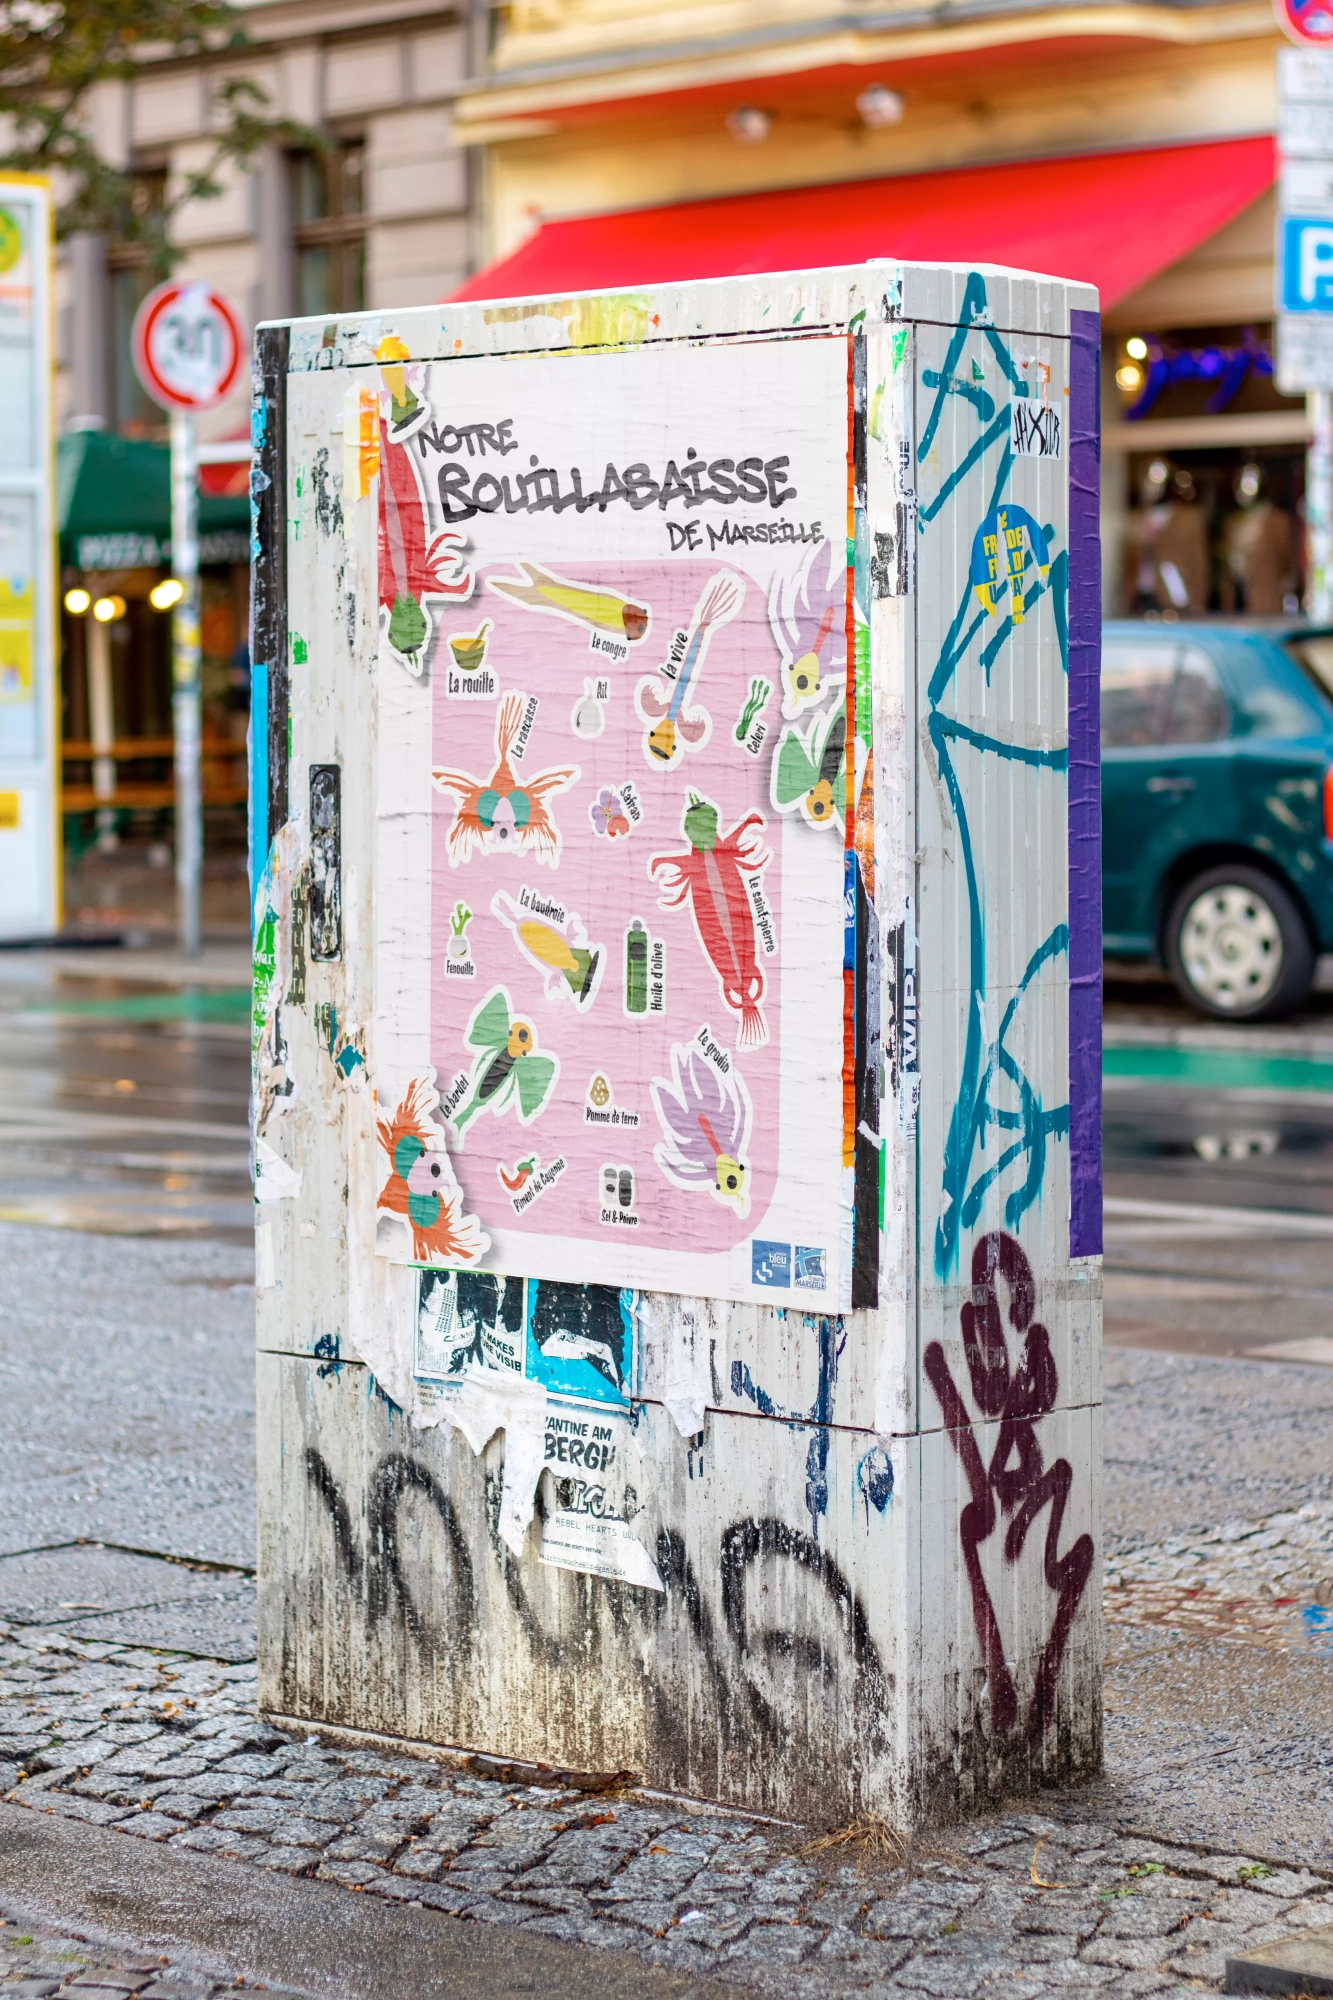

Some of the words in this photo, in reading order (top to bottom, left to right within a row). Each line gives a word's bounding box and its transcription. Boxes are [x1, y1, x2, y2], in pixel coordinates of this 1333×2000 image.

[418, 419, 519, 458] NOTRE
[438, 447, 798, 524] BOUILLABAISSE
[666, 519, 703, 551] DE
[706, 516, 825, 551] MARSEILLE
[592, 632, 601, 648] Le
[601, 639, 627, 660] congre
[671, 632, 688, 662] vive
[448, 671, 459, 694] La
[462, 671, 495, 694] rouille
[596, 681, 608, 699] Ail
[510, 744, 524, 759] La
[517, 696, 538, 744] rascasse
[620, 785, 640, 822] Safran
[748, 875, 761, 889] Le
[519, 888, 530, 906] La
[531, 891, 565, 924] baudroie
[752, 892, 775, 953] saint-pierre
[446, 960, 474, 976] Fenouille
[651, 943, 663, 977] d'olive
[651, 978, 663, 1012] Huile
[697, 1028, 708, 1045] Le
[439, 1104, 452, 1120] Le
[448, 1074, 471, 1107] bardet
[586, 1106, 610, 1122] Pomme
[611, 1109, 620, 1124] de
[621, 1112, 639, 1126] terre
[513, 1185, 536, 1213] Piment
[532, 1179, 544, 1193] de
[540, 1159, 565, 1184] Cayenne
[601, 1209, 610, 1222] Sel
[611, 1210, 619, 1223] &
[619, 1211, 638, 1225] Poivre
[769, 1252, 787, 1264] bleu
[795, 1280, 825, 1289] MARSEILLE
[486, 1332, 515, 1357] MAKES
[545, 1416, 589, 1438] ANTINE
[592, 1425, 613, 1442] AM
[556, 1517, 581, 1531] REBEL
[585, 1523, 618, 1537] HEARTS
